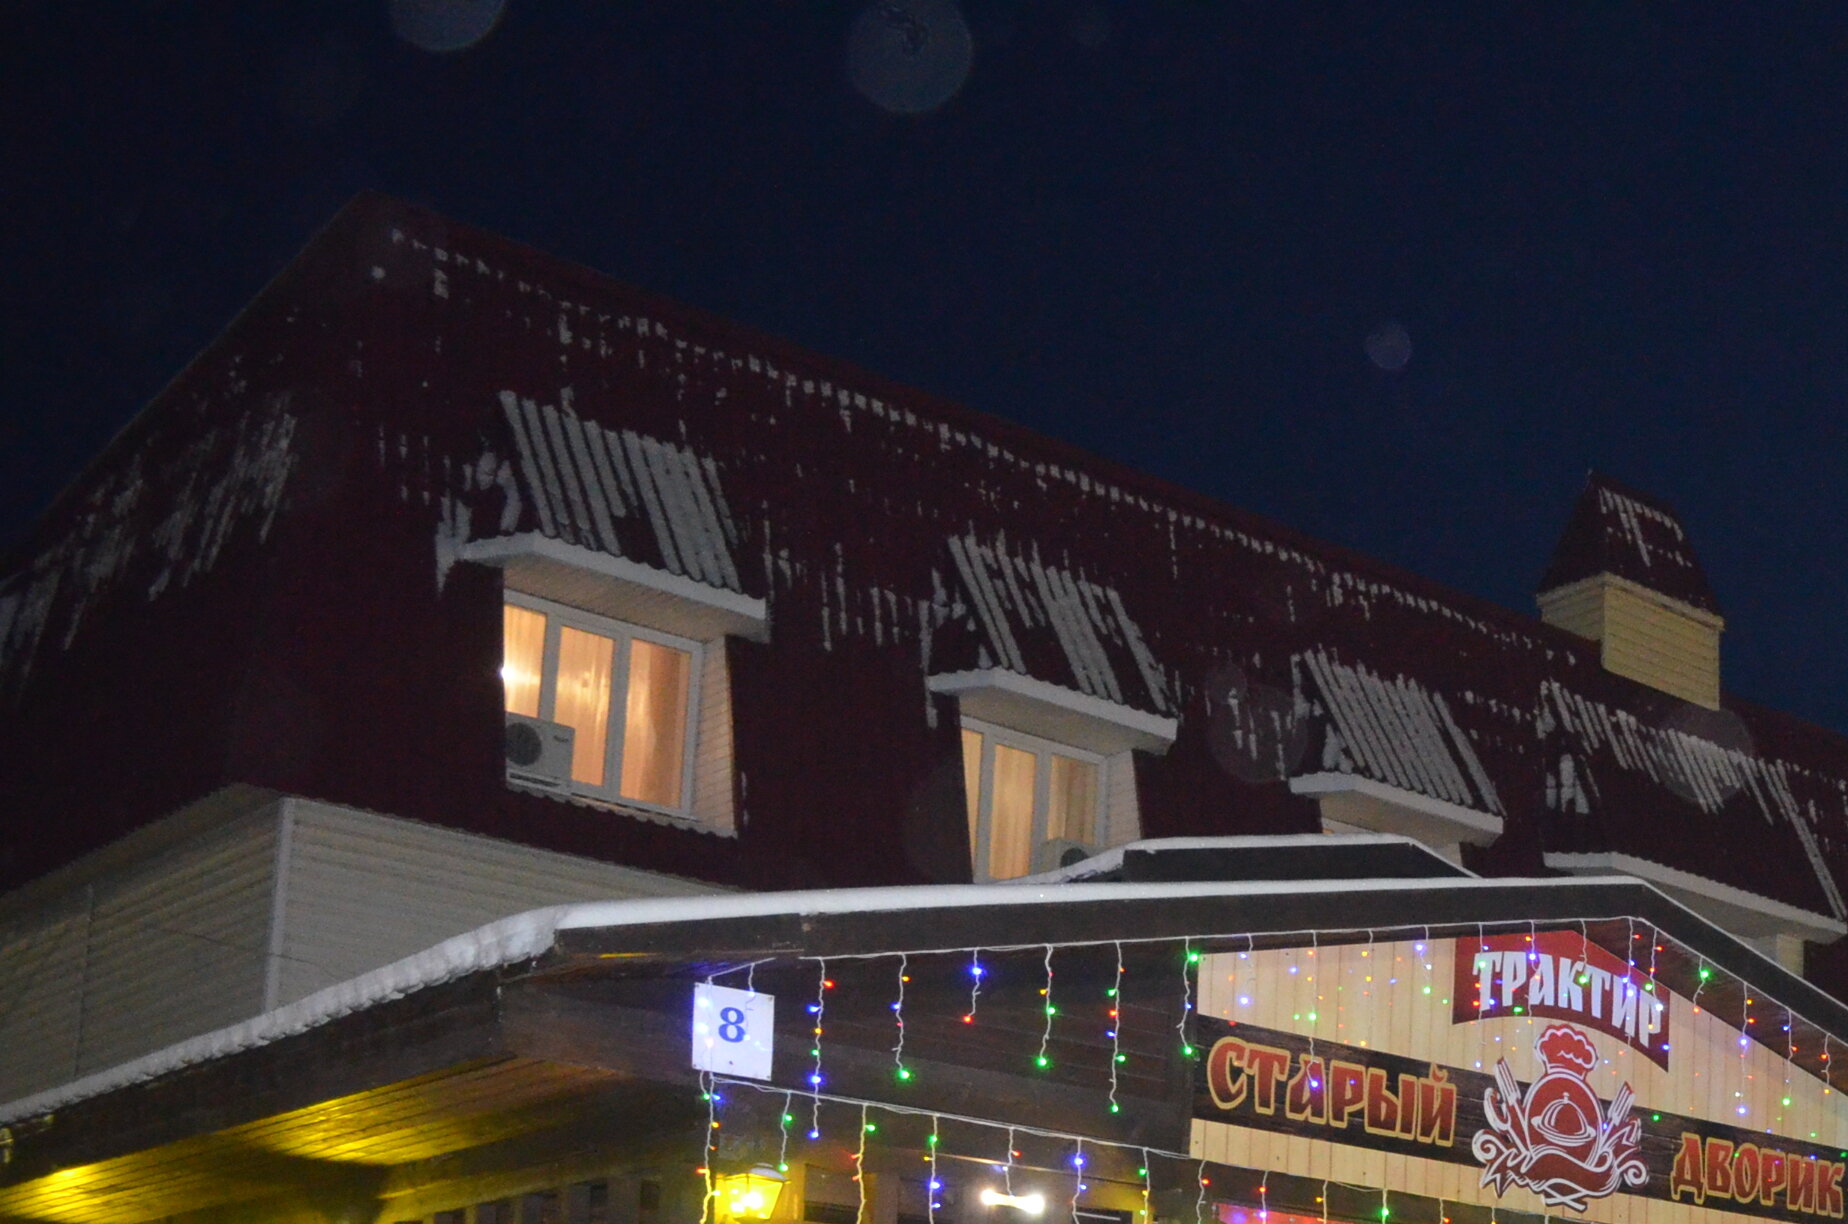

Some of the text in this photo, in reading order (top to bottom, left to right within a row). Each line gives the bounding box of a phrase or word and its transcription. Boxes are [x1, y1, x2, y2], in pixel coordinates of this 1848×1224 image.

[718, 1007, 746, 1043] 8
[1472, 950, 1662, 1049] ТРАКТИР
[1207, 1034, 1457, 1148] СТАРЫЙ
[1671, 1131, 1846, 1220] ДВОРИК
